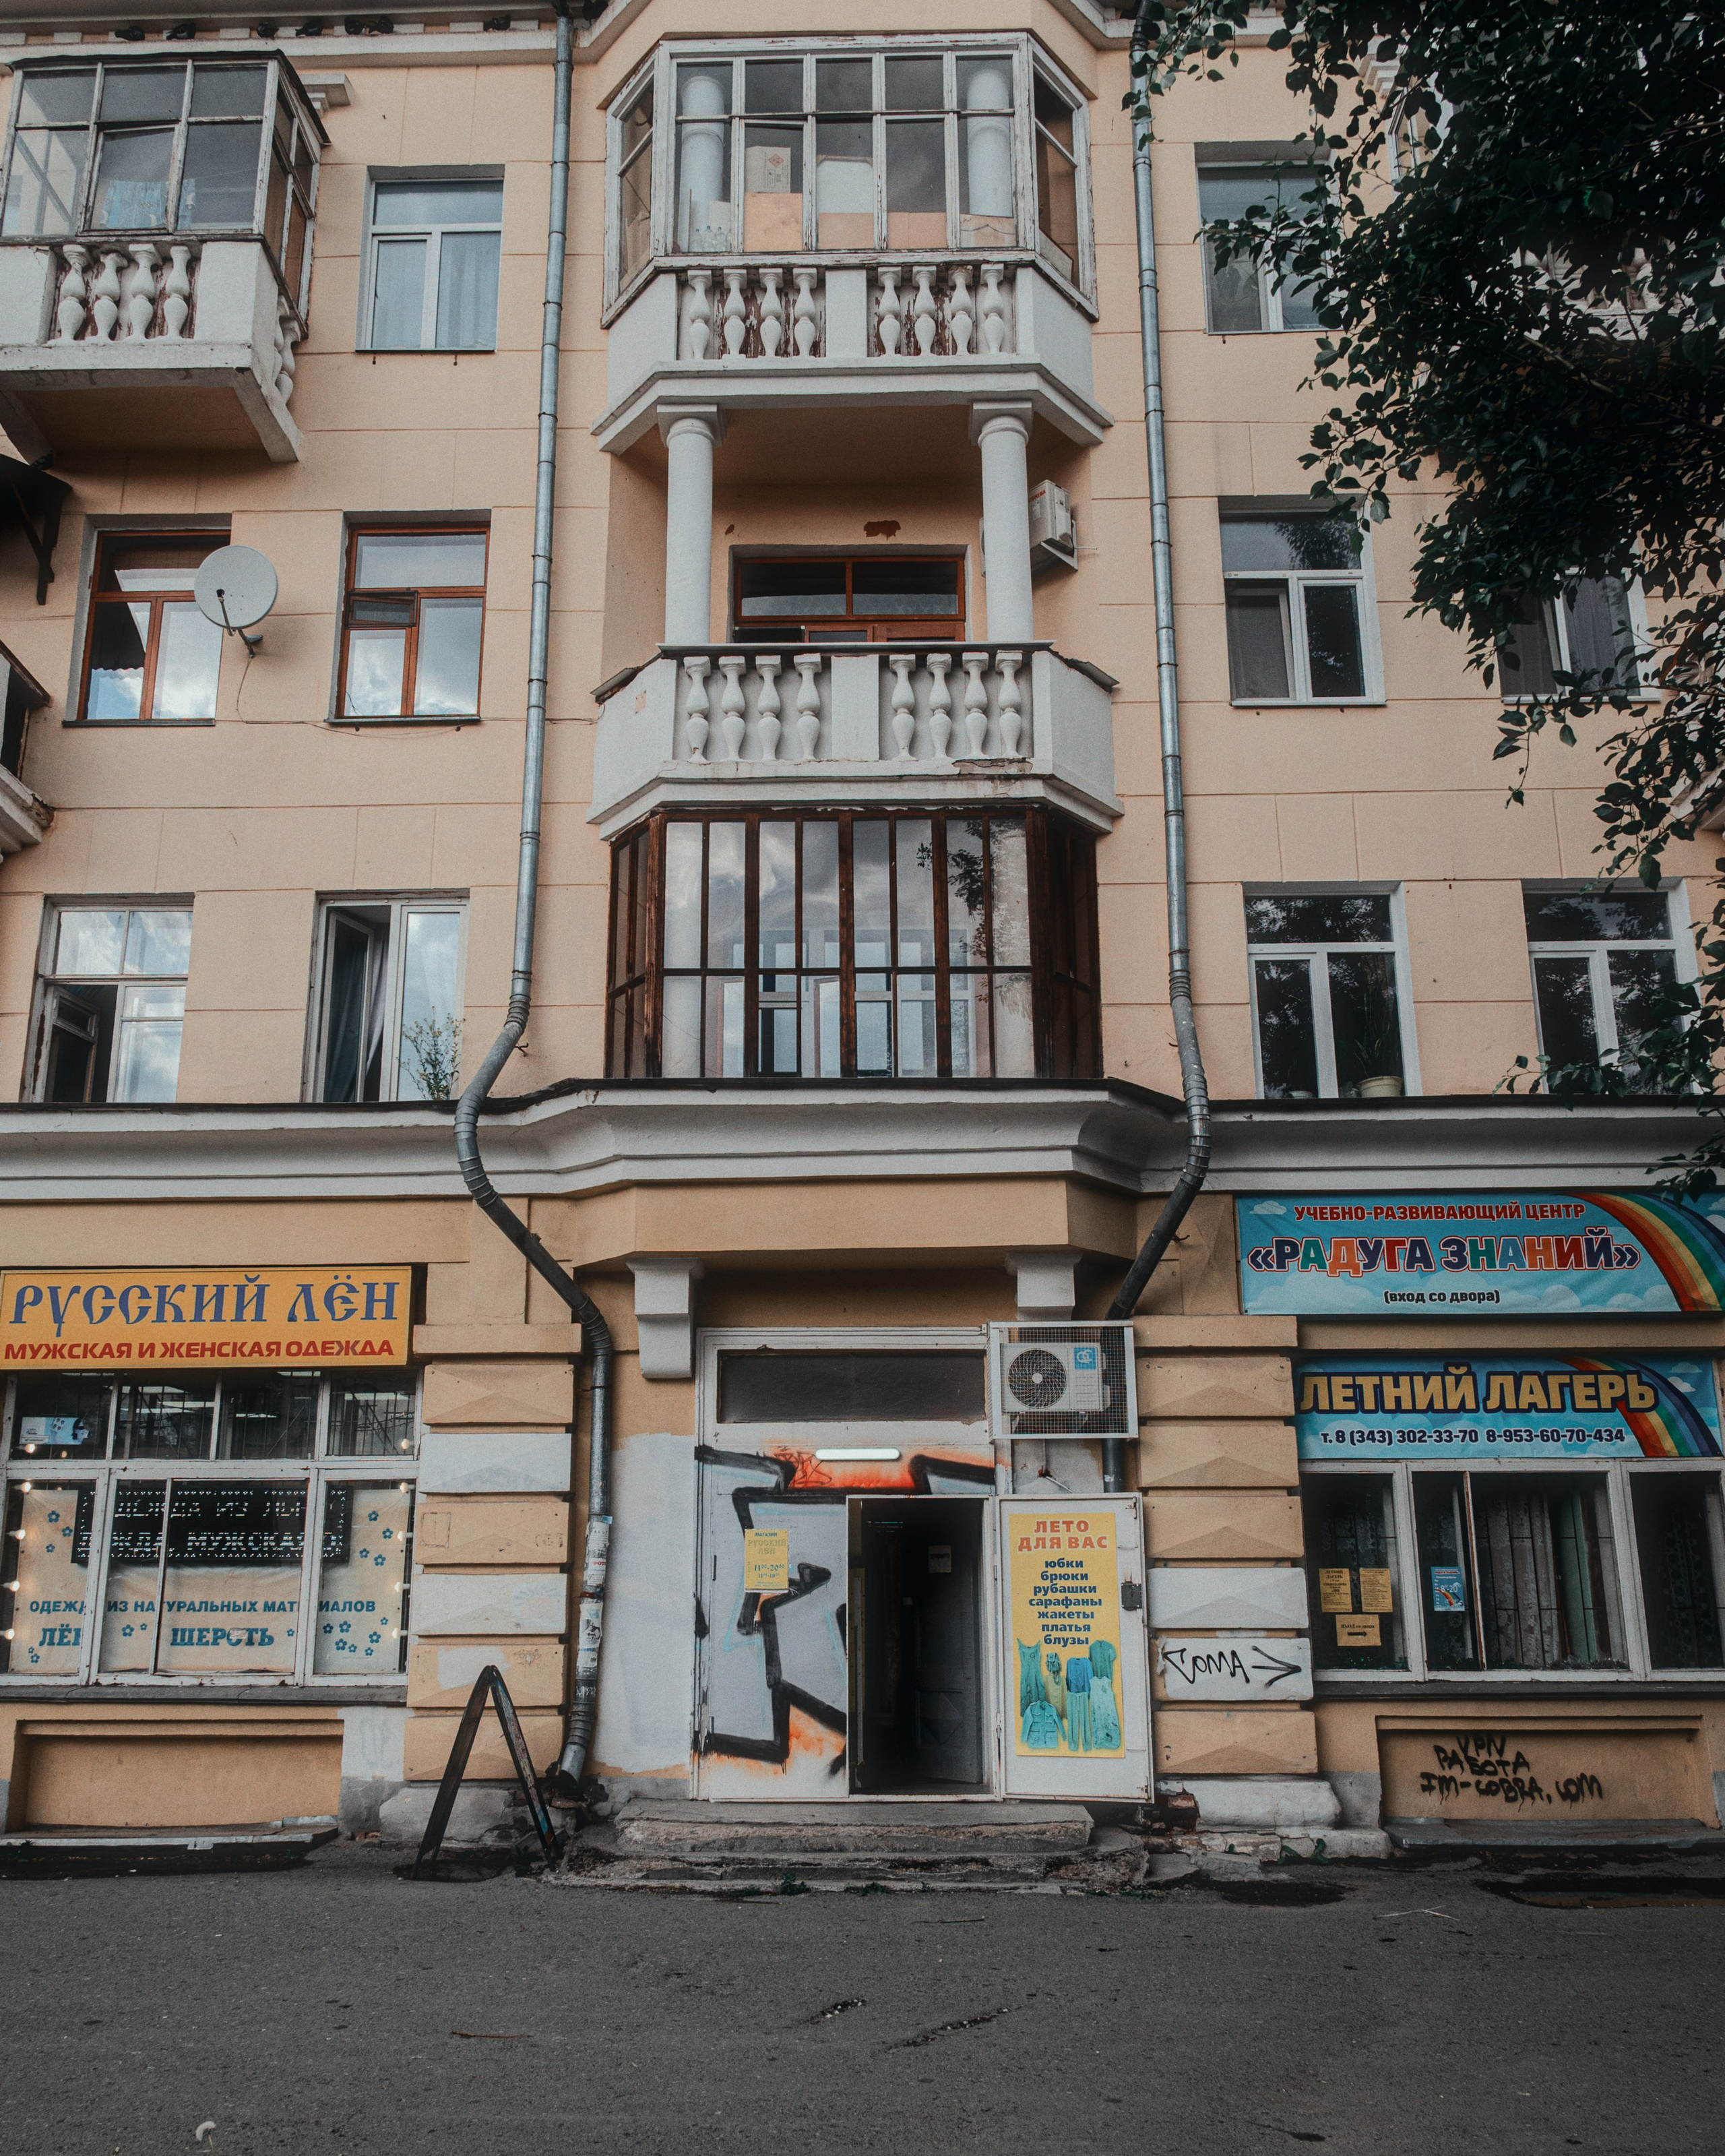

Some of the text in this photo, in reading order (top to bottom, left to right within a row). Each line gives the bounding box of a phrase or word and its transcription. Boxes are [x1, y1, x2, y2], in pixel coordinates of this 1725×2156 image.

[1028, 490, 1046, 502] OSHIBA
[1294, 1201, 1586, 1221] УЧЕБНО-РАЗВИВАЮЩИЙ ЦЕНТР
[1248, 1227, 1641, 1277] «РАДУГА ЗНАНИЙ»
[1384, 1290, 1500, 1304] (вход со двора)
[9, 1274, 400, 1337] РУССКИЙ ЛЁН
[5, 1340, 394, 1359] МУЖСКАЯ И ЖЕНСКАЯ ОДЕЖДА
[1297, 1363, 1659, 1413] ЛЕТНИЙ ЛАГЕРЬ
[1321, 1429, 1625, 1446] т. 8 (343) 302-33-70 8-953-60-70-434
[1034, 1520, 1090, 1533] ЛЕТО
[1017, 1536, 1107, 1552] ДЛЯ ВАС
[1044, 1558, 1084, 1568] юбки
[1040, 1571, 1088, 1583] брюки
[1033, 1583, 1096, 1596] рубашки
[30, 1600, 376, 1614] ОДЕЖ ИЗ НАУРАЛЬНЫХ МАТИАЛОВ
[1028, 1596, 1102, 1609] сарафаны
[1037, 1611, 1094, 1619] жакеты
[1041, 1624, 1091, 1632] платья
[1044, 1634, 1089, 1648] блузы
